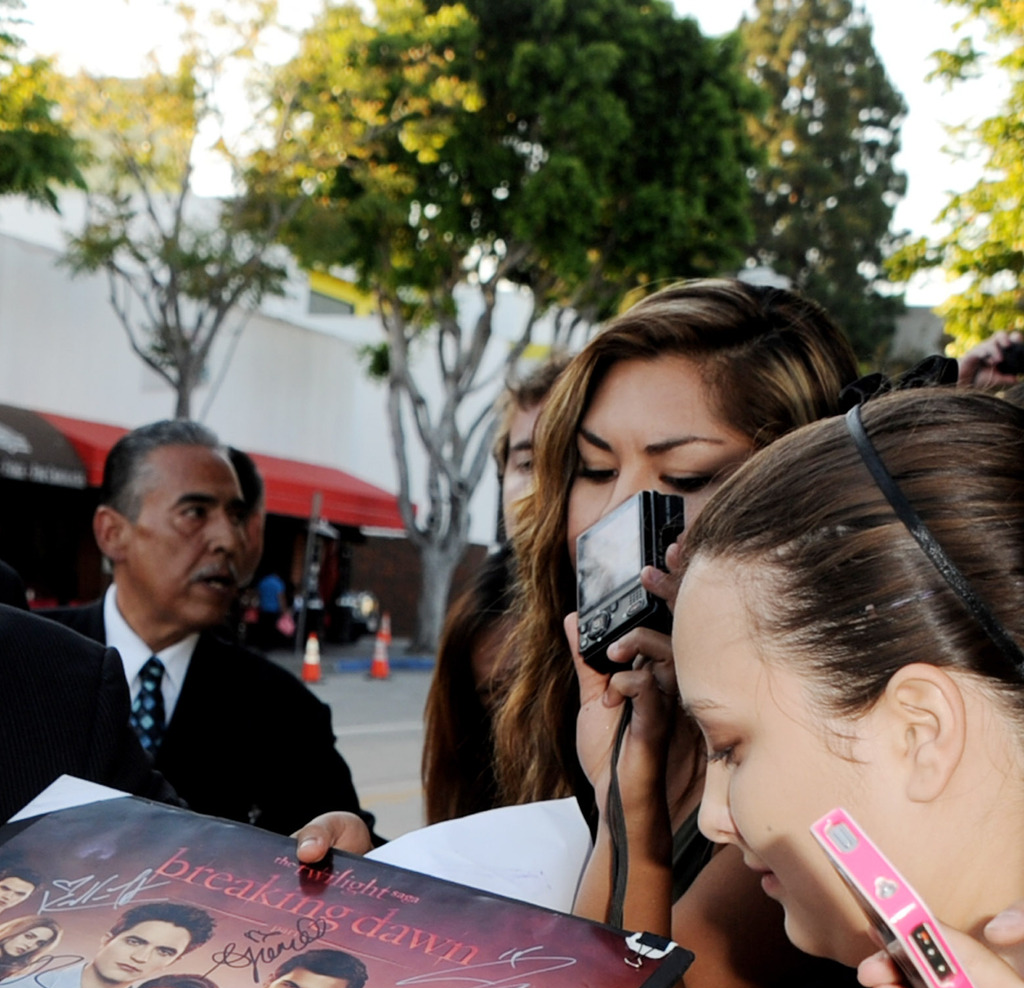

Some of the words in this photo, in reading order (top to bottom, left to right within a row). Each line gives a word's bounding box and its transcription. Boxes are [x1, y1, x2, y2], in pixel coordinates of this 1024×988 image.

[155, 848, 354, 933] breaking
[351, 907, 481, 967] dawn
[296, 863, 393, 901] twilight
[390, 888, 421, 905] saga
